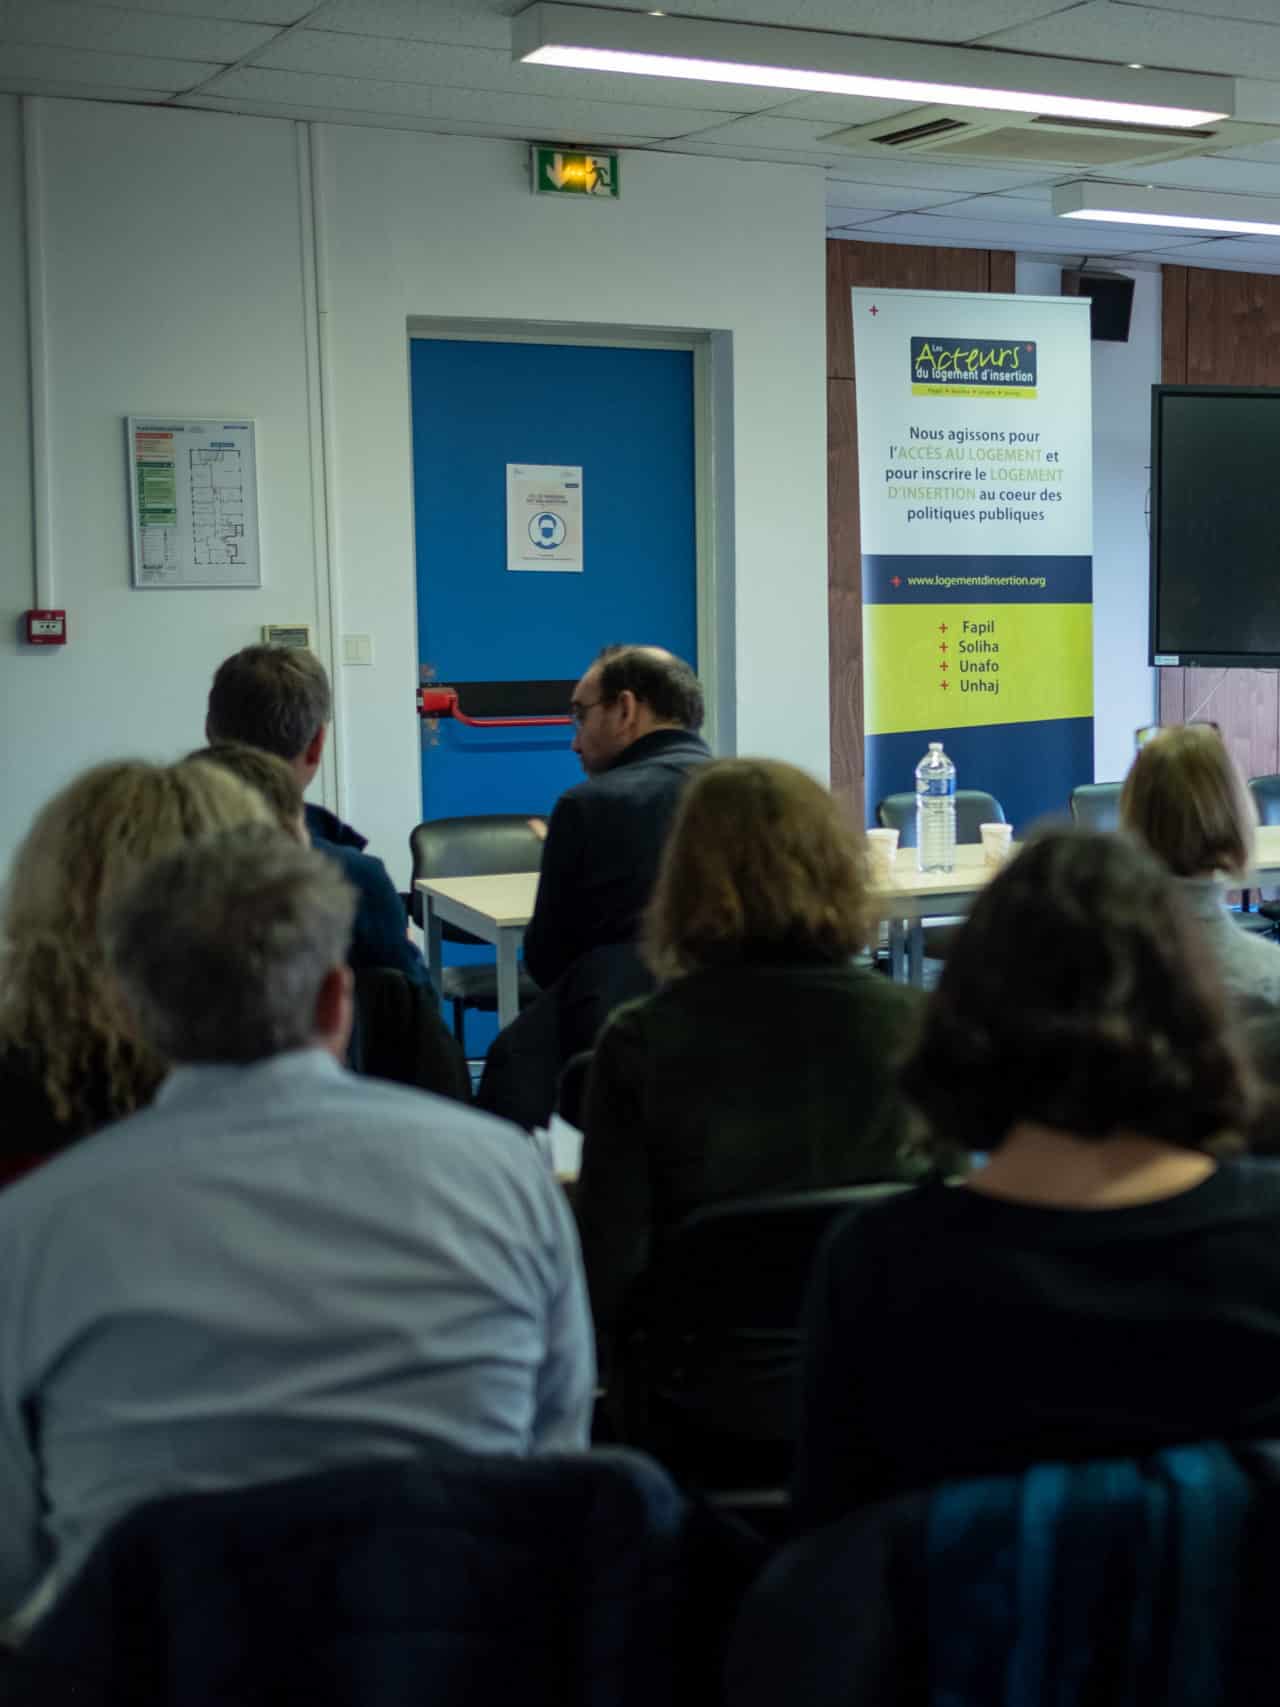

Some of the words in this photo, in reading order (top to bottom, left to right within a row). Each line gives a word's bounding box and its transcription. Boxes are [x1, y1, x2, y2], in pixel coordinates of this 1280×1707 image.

[915, 343, 1020, 371] Acteurs
[916, 368, 929, 378] du
[932, 368, 978, 381] logement
[981, 370, 1033, 382] d'insertion
[910, 427, 944, 441] Nous
[948, 428, 1005, 444] agissons
[1009, 432, 1040, 445] pour
[946, 449, 966, 461] AU
[969, 449, 1041, 462] LOGEMENT
[1046, 452, 1059, 462] et
[885, 469, 918, 482] pour
[922, 468, 972, 480] inscrire
[976, 468, 986, 480] le
[991, 469, 1064, 481] LOGEMENT
[888, 487, 976, 499] D'INSERTION
[979, 490, 996, 501] au
[999, 490, 1036, 501] coeur
[1040, 488, 1063, 502] des
[907, 507, 976, 524] politiques
[979, 507, 1045, 524] publiques
[907, 575, 1046, 588] www.logementdinsertion.org
[962, 620, 995, 636] Fapil
[959, 640, 999, 653] Soliha
[959, 660, 999, 673] Unafo
[960, 679, 1000, 695] Unhaj
